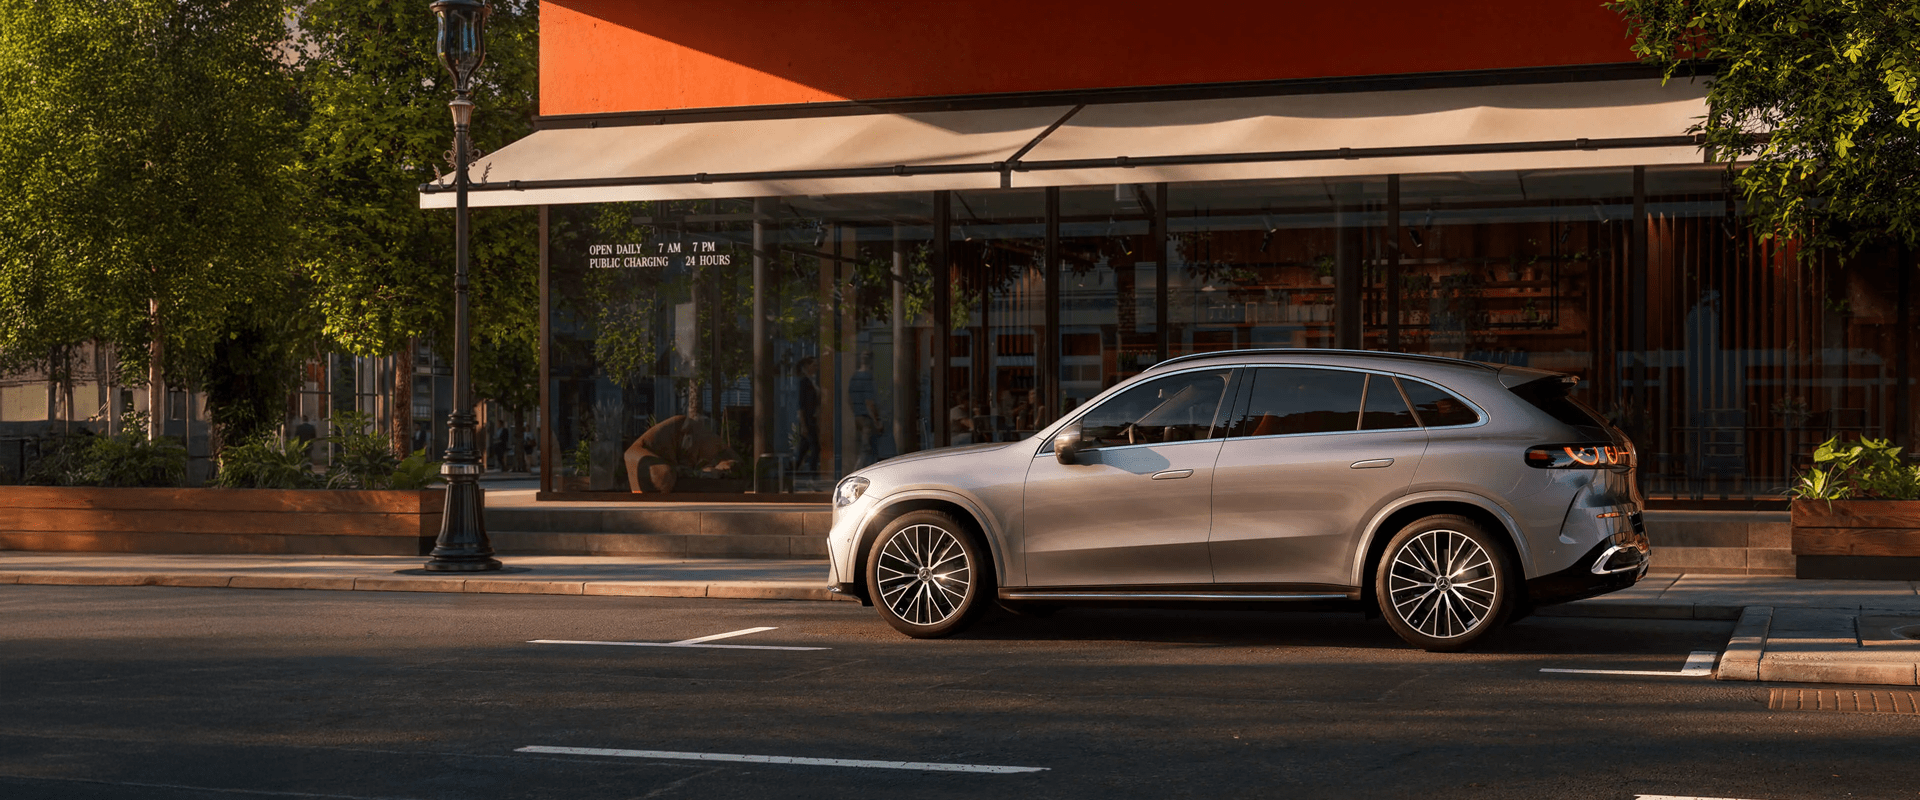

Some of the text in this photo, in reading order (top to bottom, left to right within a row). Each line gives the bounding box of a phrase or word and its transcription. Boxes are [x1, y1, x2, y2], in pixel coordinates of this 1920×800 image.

[589, 241, 715, 255] OPEN DAILY 7 AM 7 PM
[589, 255, 731, 269] PUBLIC CHARGING 24 HOURS
